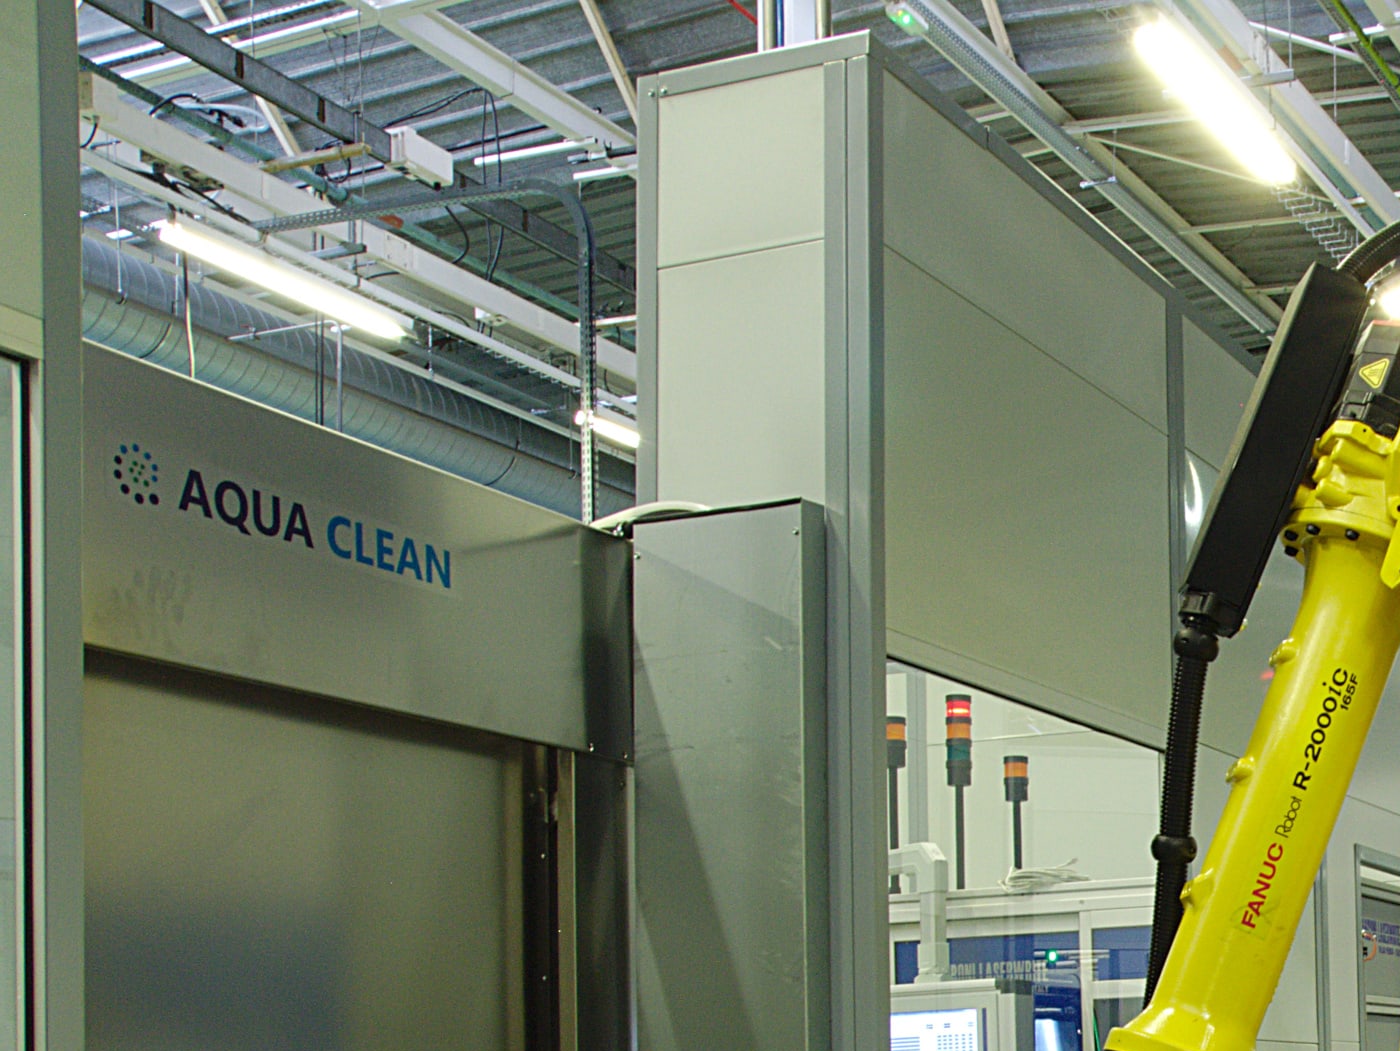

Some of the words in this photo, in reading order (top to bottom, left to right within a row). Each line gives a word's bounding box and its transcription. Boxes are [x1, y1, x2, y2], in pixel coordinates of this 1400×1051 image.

[178, 468, 314, 549] AQUA
[327, 515, 451, 589] CLEAN
[1340, 673, 1359, 711] 165F
[1241, 842, 1284, 929] FANUC
[1274, 796, 1303, 838] Robot
[1292, 667, 1348, 791] R-2000iC
